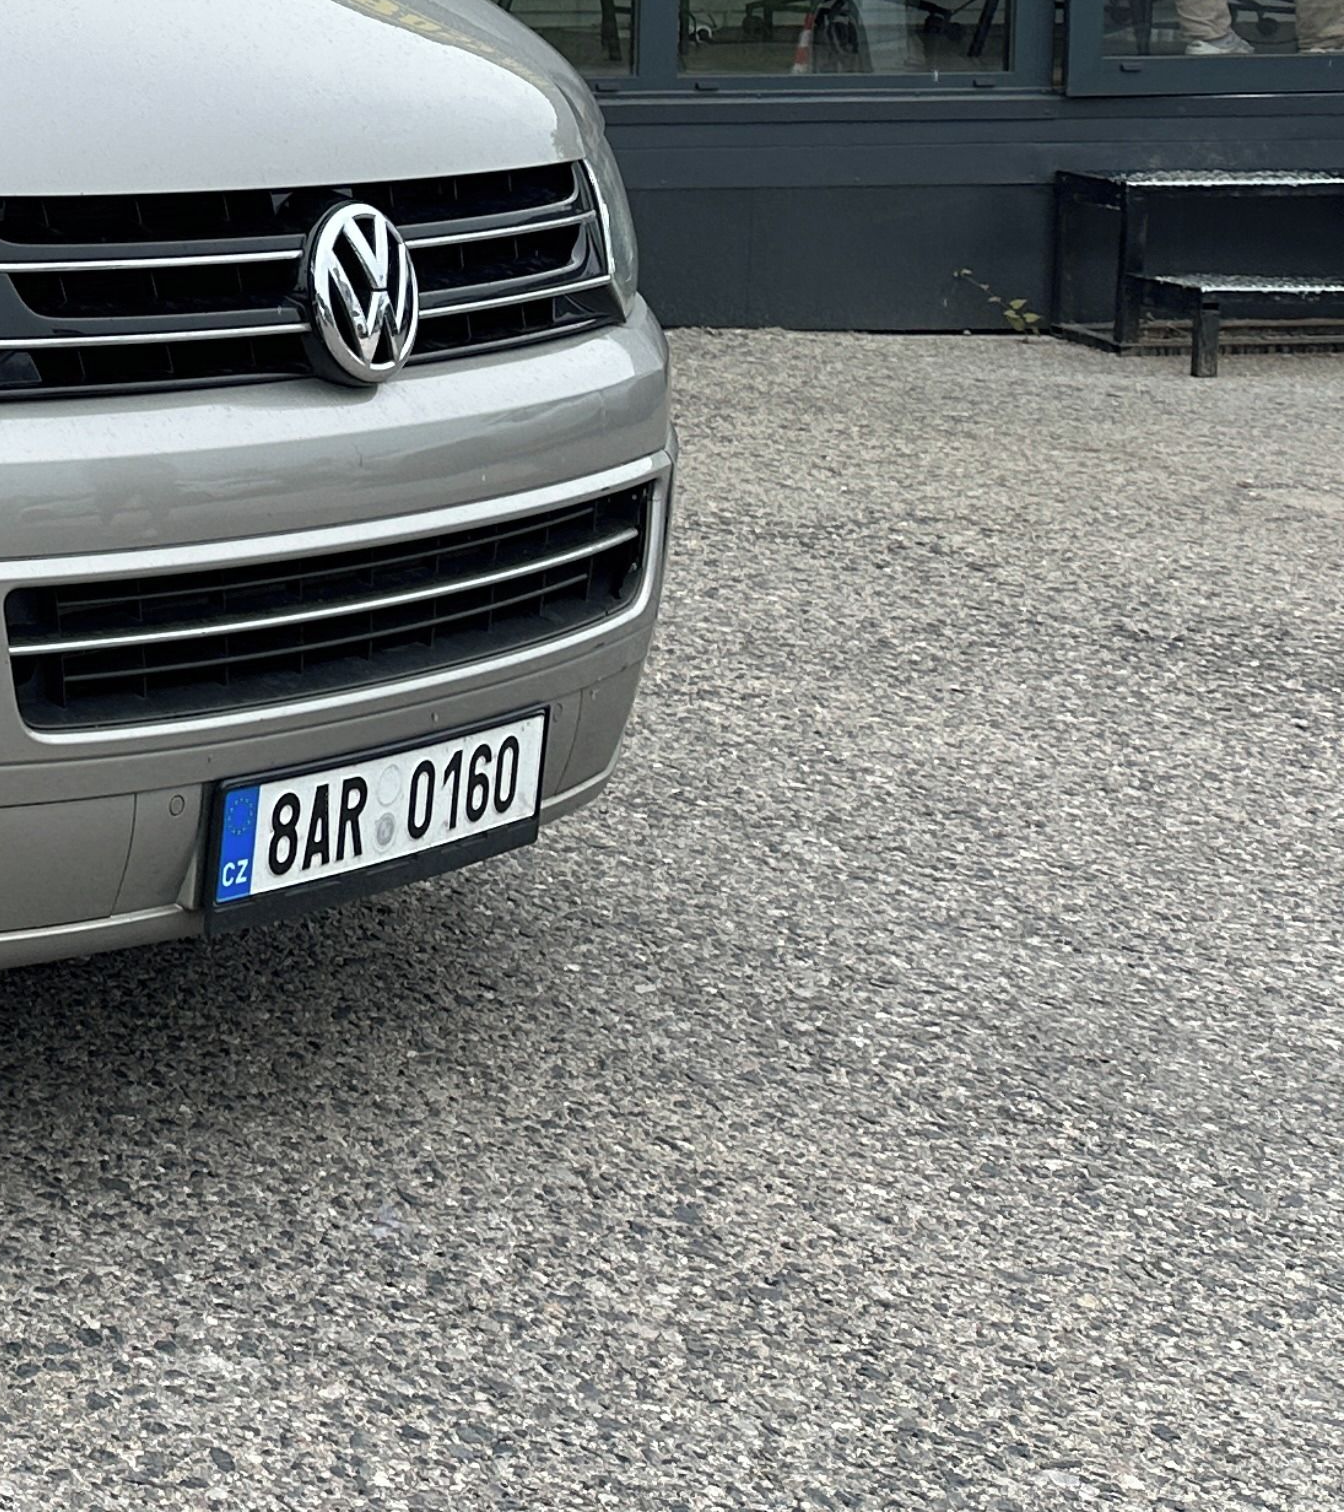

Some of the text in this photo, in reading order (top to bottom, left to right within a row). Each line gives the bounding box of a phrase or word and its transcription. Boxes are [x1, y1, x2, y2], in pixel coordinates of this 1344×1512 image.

[267, 734, 521, 877] 8AR 0160
[222, 859, 249, 888] CZ
